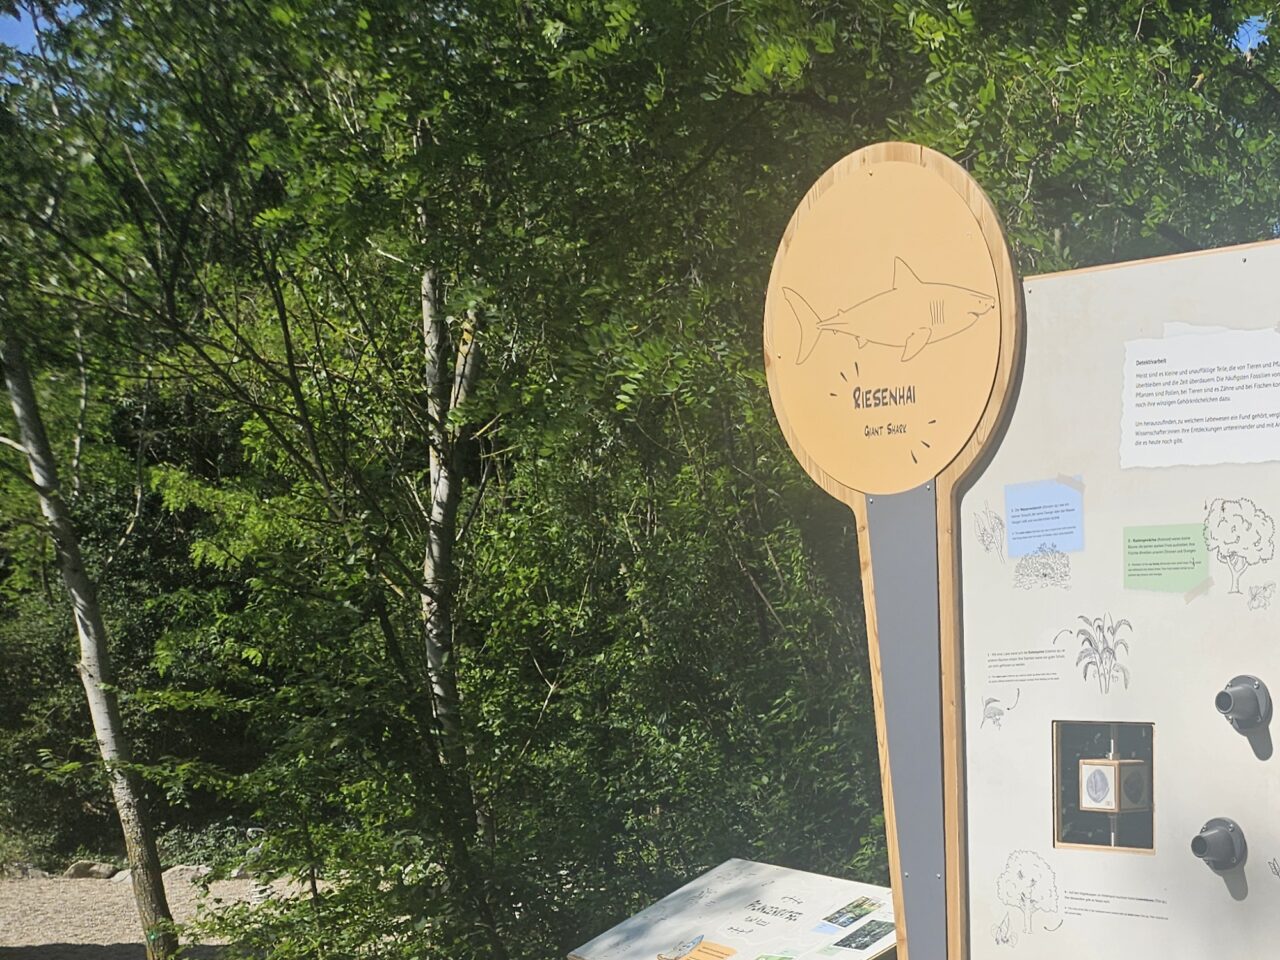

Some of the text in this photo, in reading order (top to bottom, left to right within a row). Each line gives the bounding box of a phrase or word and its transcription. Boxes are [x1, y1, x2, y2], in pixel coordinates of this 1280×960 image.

[853, 385, 916, 409] RIESENHAI
[864, 423, 908, 438] GIANT SHARK
